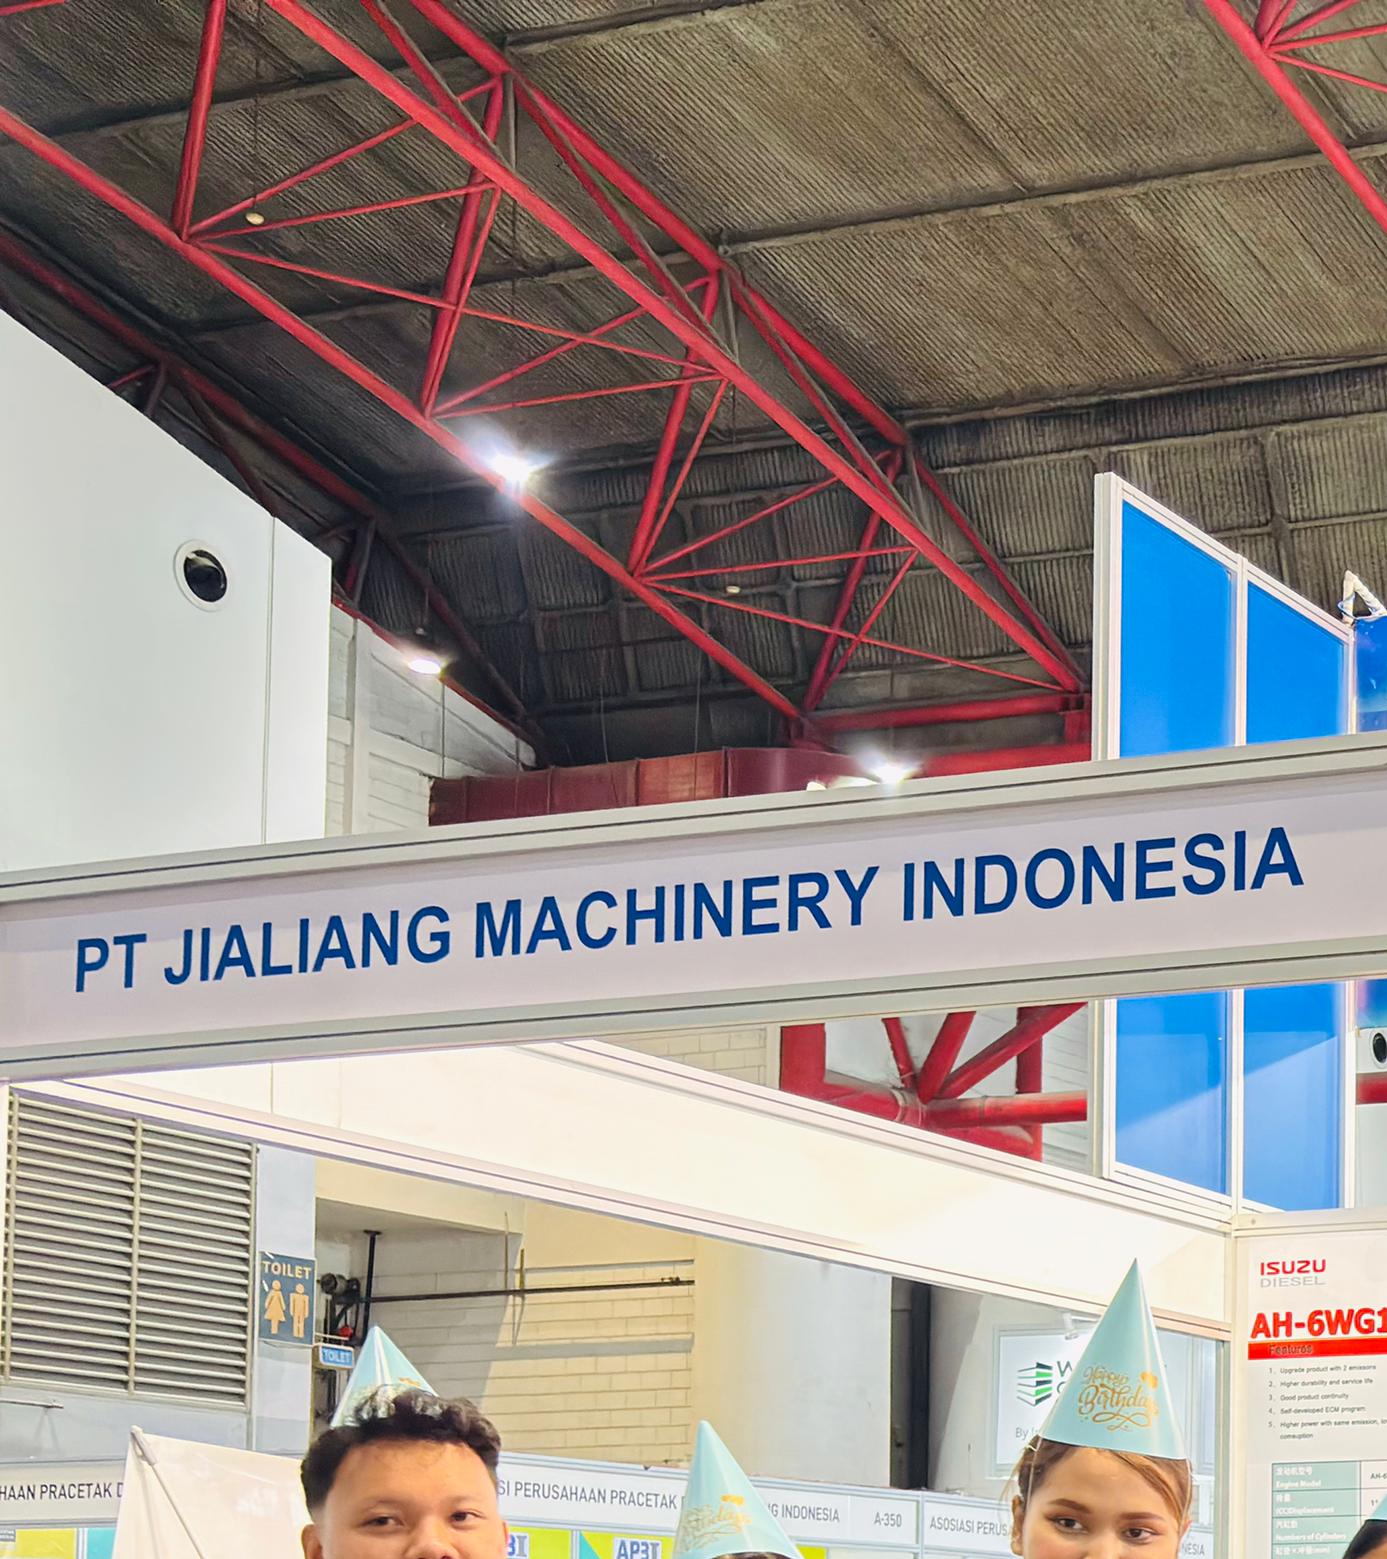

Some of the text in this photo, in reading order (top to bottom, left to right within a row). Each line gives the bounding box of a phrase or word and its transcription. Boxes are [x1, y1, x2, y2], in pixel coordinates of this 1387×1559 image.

[75, 826, 1305, 993] PT JIALIANG MACHINERY INDONESIA
[262, 1261, 312, 1279] TOILET
[1260, 1259, 1326, 1275] ISUZU
[1260, 1276, 1326, 1288] DIESEL
[322, 1349, 352, 1363] TOILET
[1268, 1344, 1312, 1355] Features
[40, 1481, 112, 1500] PRACETAK
[515, 1481, 678, 1510] PERUSAHAAN PRACETAK
[782, 1499, 840, 1523] INDONESIA
[873, 1510, 903, 1529] A-350
[929, 1514, 976, 1535] ASOSIASI
